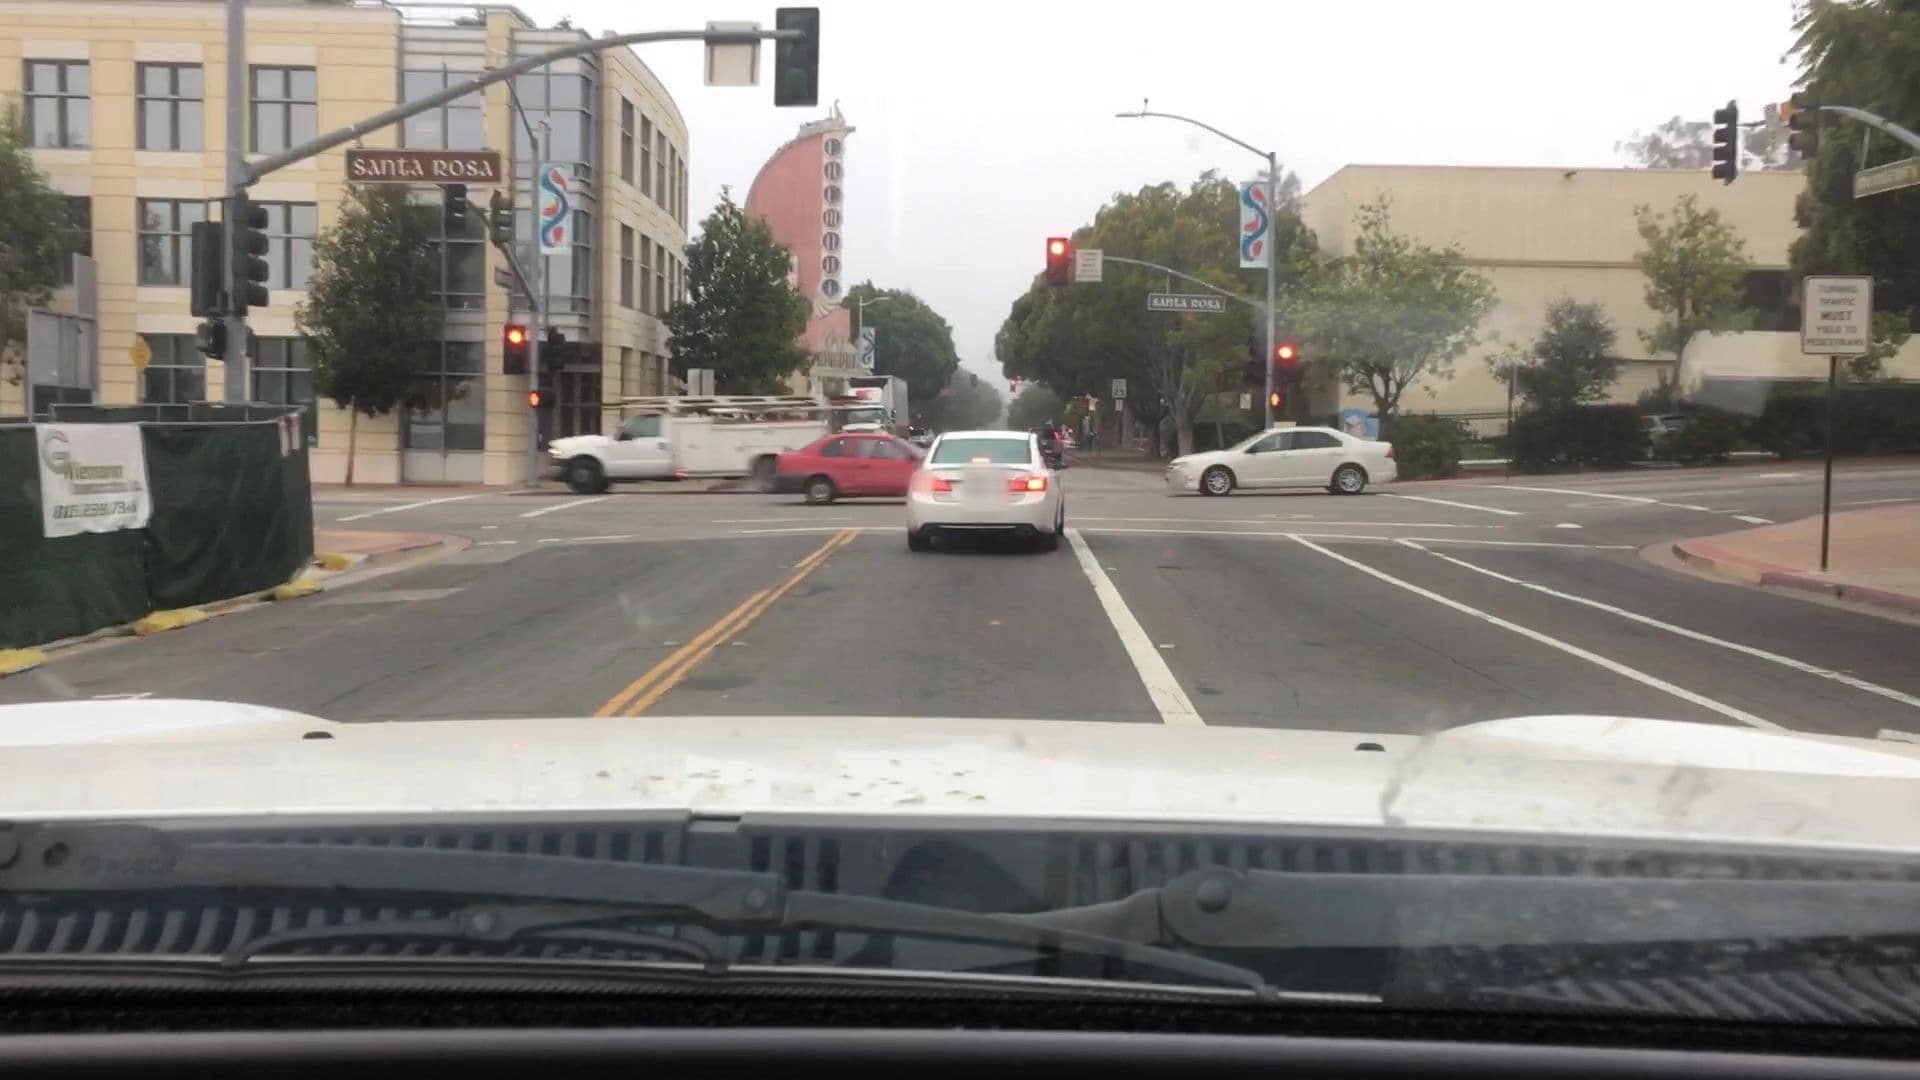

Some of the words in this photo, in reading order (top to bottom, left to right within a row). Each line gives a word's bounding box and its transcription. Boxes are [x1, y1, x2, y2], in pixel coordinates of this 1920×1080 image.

[353, 157, 425, 177] SANTA
[431, 159, 493, 177] ROSA
[1151, 297, 1188, 308] SANTA
[1190, 299, 1221, 309] ROSA
[1821, 311, 1852, 321] MUST
